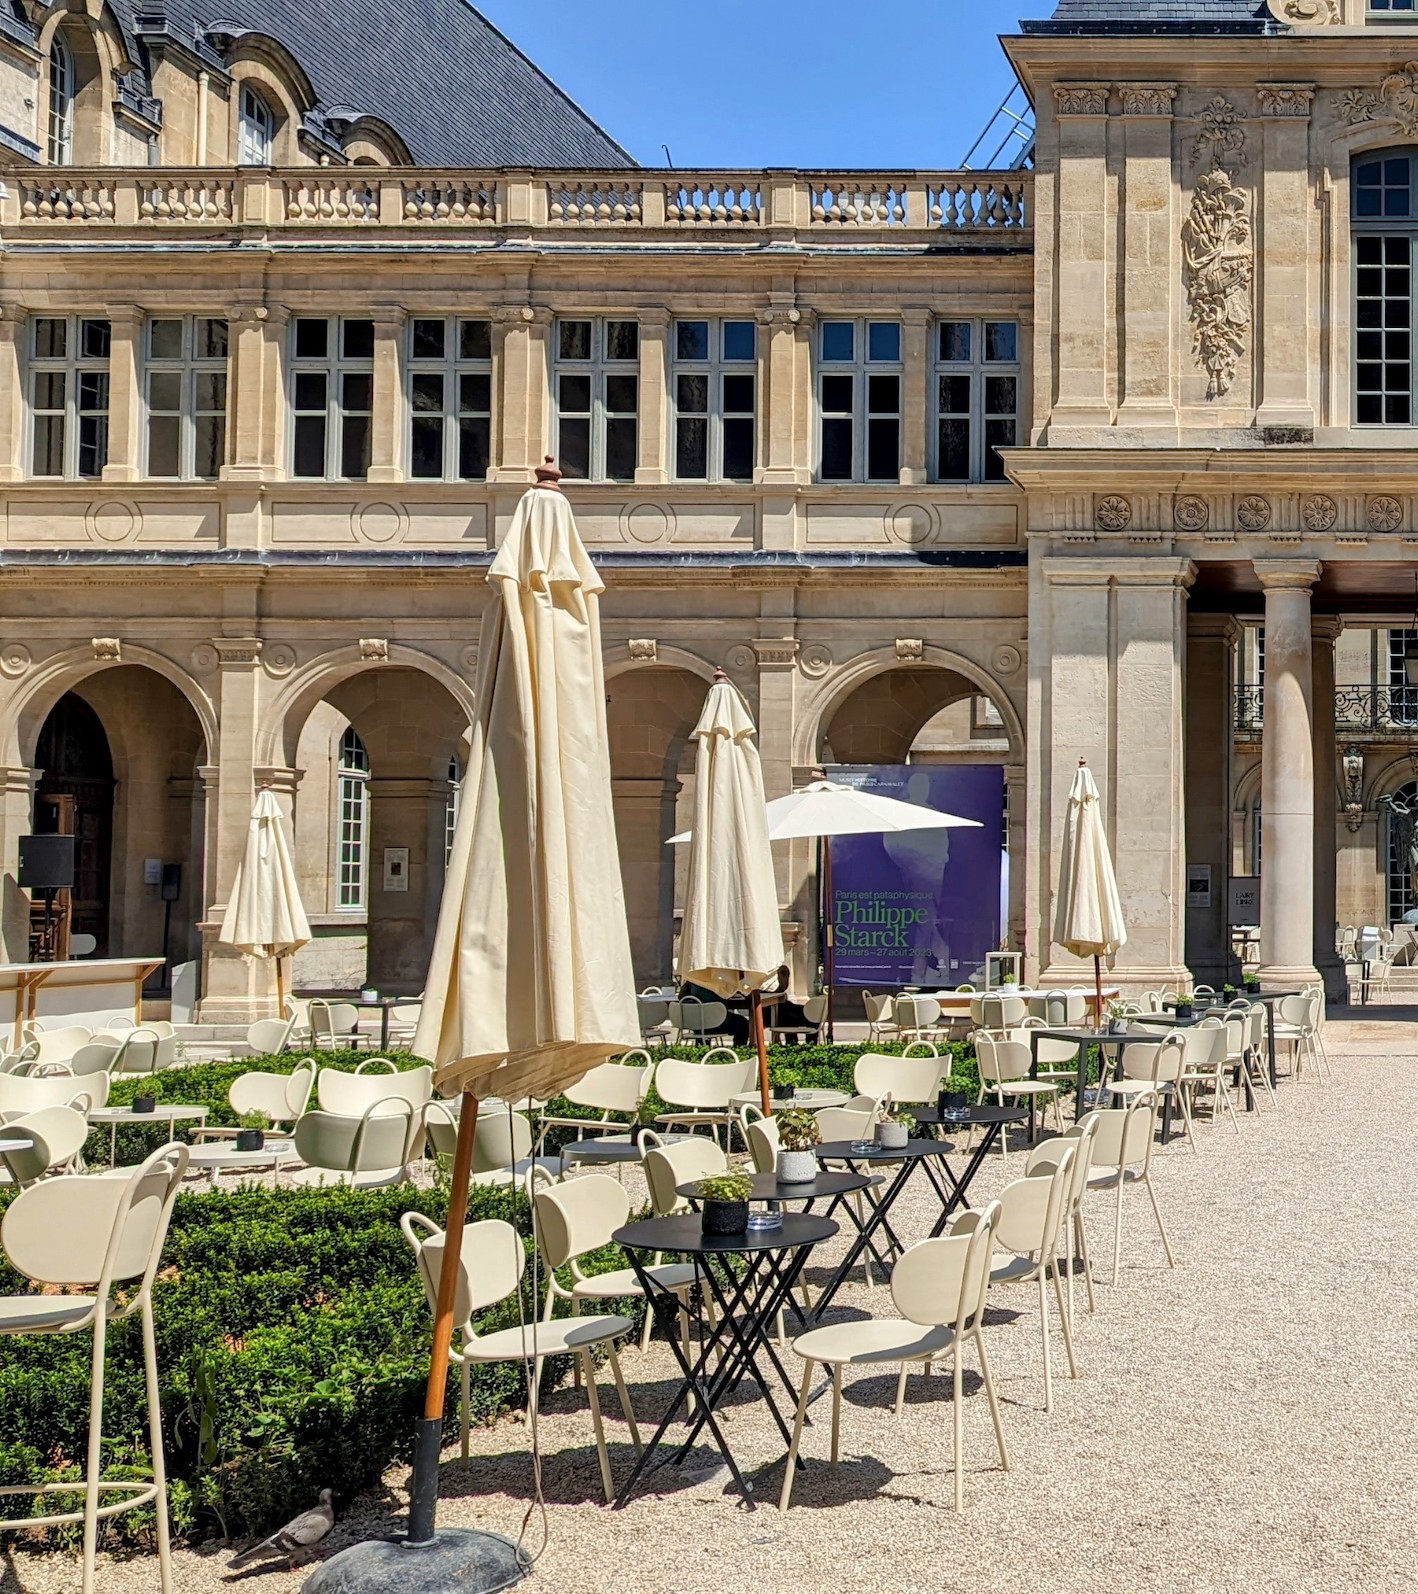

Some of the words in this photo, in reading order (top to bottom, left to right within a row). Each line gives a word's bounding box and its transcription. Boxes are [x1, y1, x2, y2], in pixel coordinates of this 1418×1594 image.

[835, 890, 858, 899] Paris
[859, 891, 872, 899] est
[834, 900, 929, 929] Philippe
[834, 923, 910, 948] Starck
[835, 948, 847, 956] 29
[876, 948, 888, 956] 27
[908, 948, 932, 957] 2023
